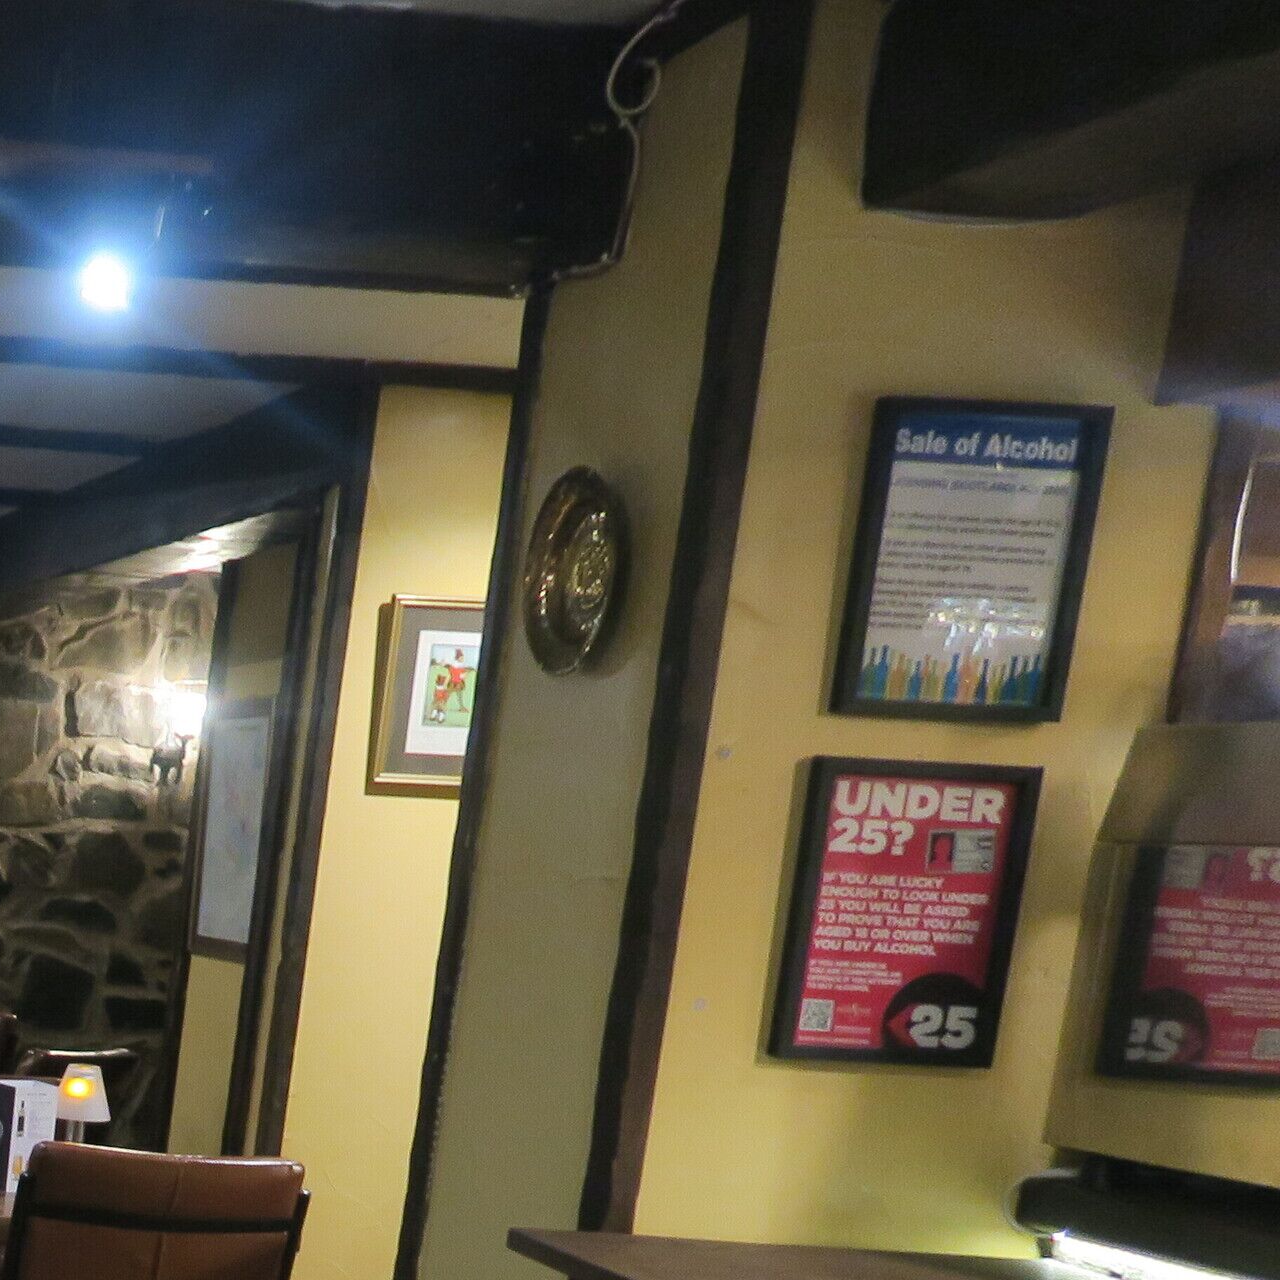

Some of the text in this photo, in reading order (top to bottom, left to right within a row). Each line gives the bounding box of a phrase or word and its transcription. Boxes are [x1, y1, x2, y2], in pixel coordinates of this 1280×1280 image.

[895, 428, 1079, 462] Sale of Alcohol
[834, 780, 1007, 823] UNDER
[828, 819, 914, 856] 25?
[839, 872, 868, 884] YOU
[868, 874, 897, 886] ARE
[898, 876, 944, 889] LUCKY
[820, 885, 989, 905] ENOUGH TO LOOK UNDER
[838, 900, 867, 911] YOU
[868, 901, 900, 913] WILL
[903, 902, 922, 915] BE
[924, 905, 970, 917] ASKED
[818, 911, 981, 932] TO PROVE THAT YOU ARE
[815, 925, 853, 938] AGED
[870, 928, 891, 940] OR
[891, 930, 931, 942] OVER
[931, 931, 975, 944] WHEN
[814, 939, 842, 951] YOU
[843, 939, 872, 952] BUY
[909, 1003, 978, 1049] 25
